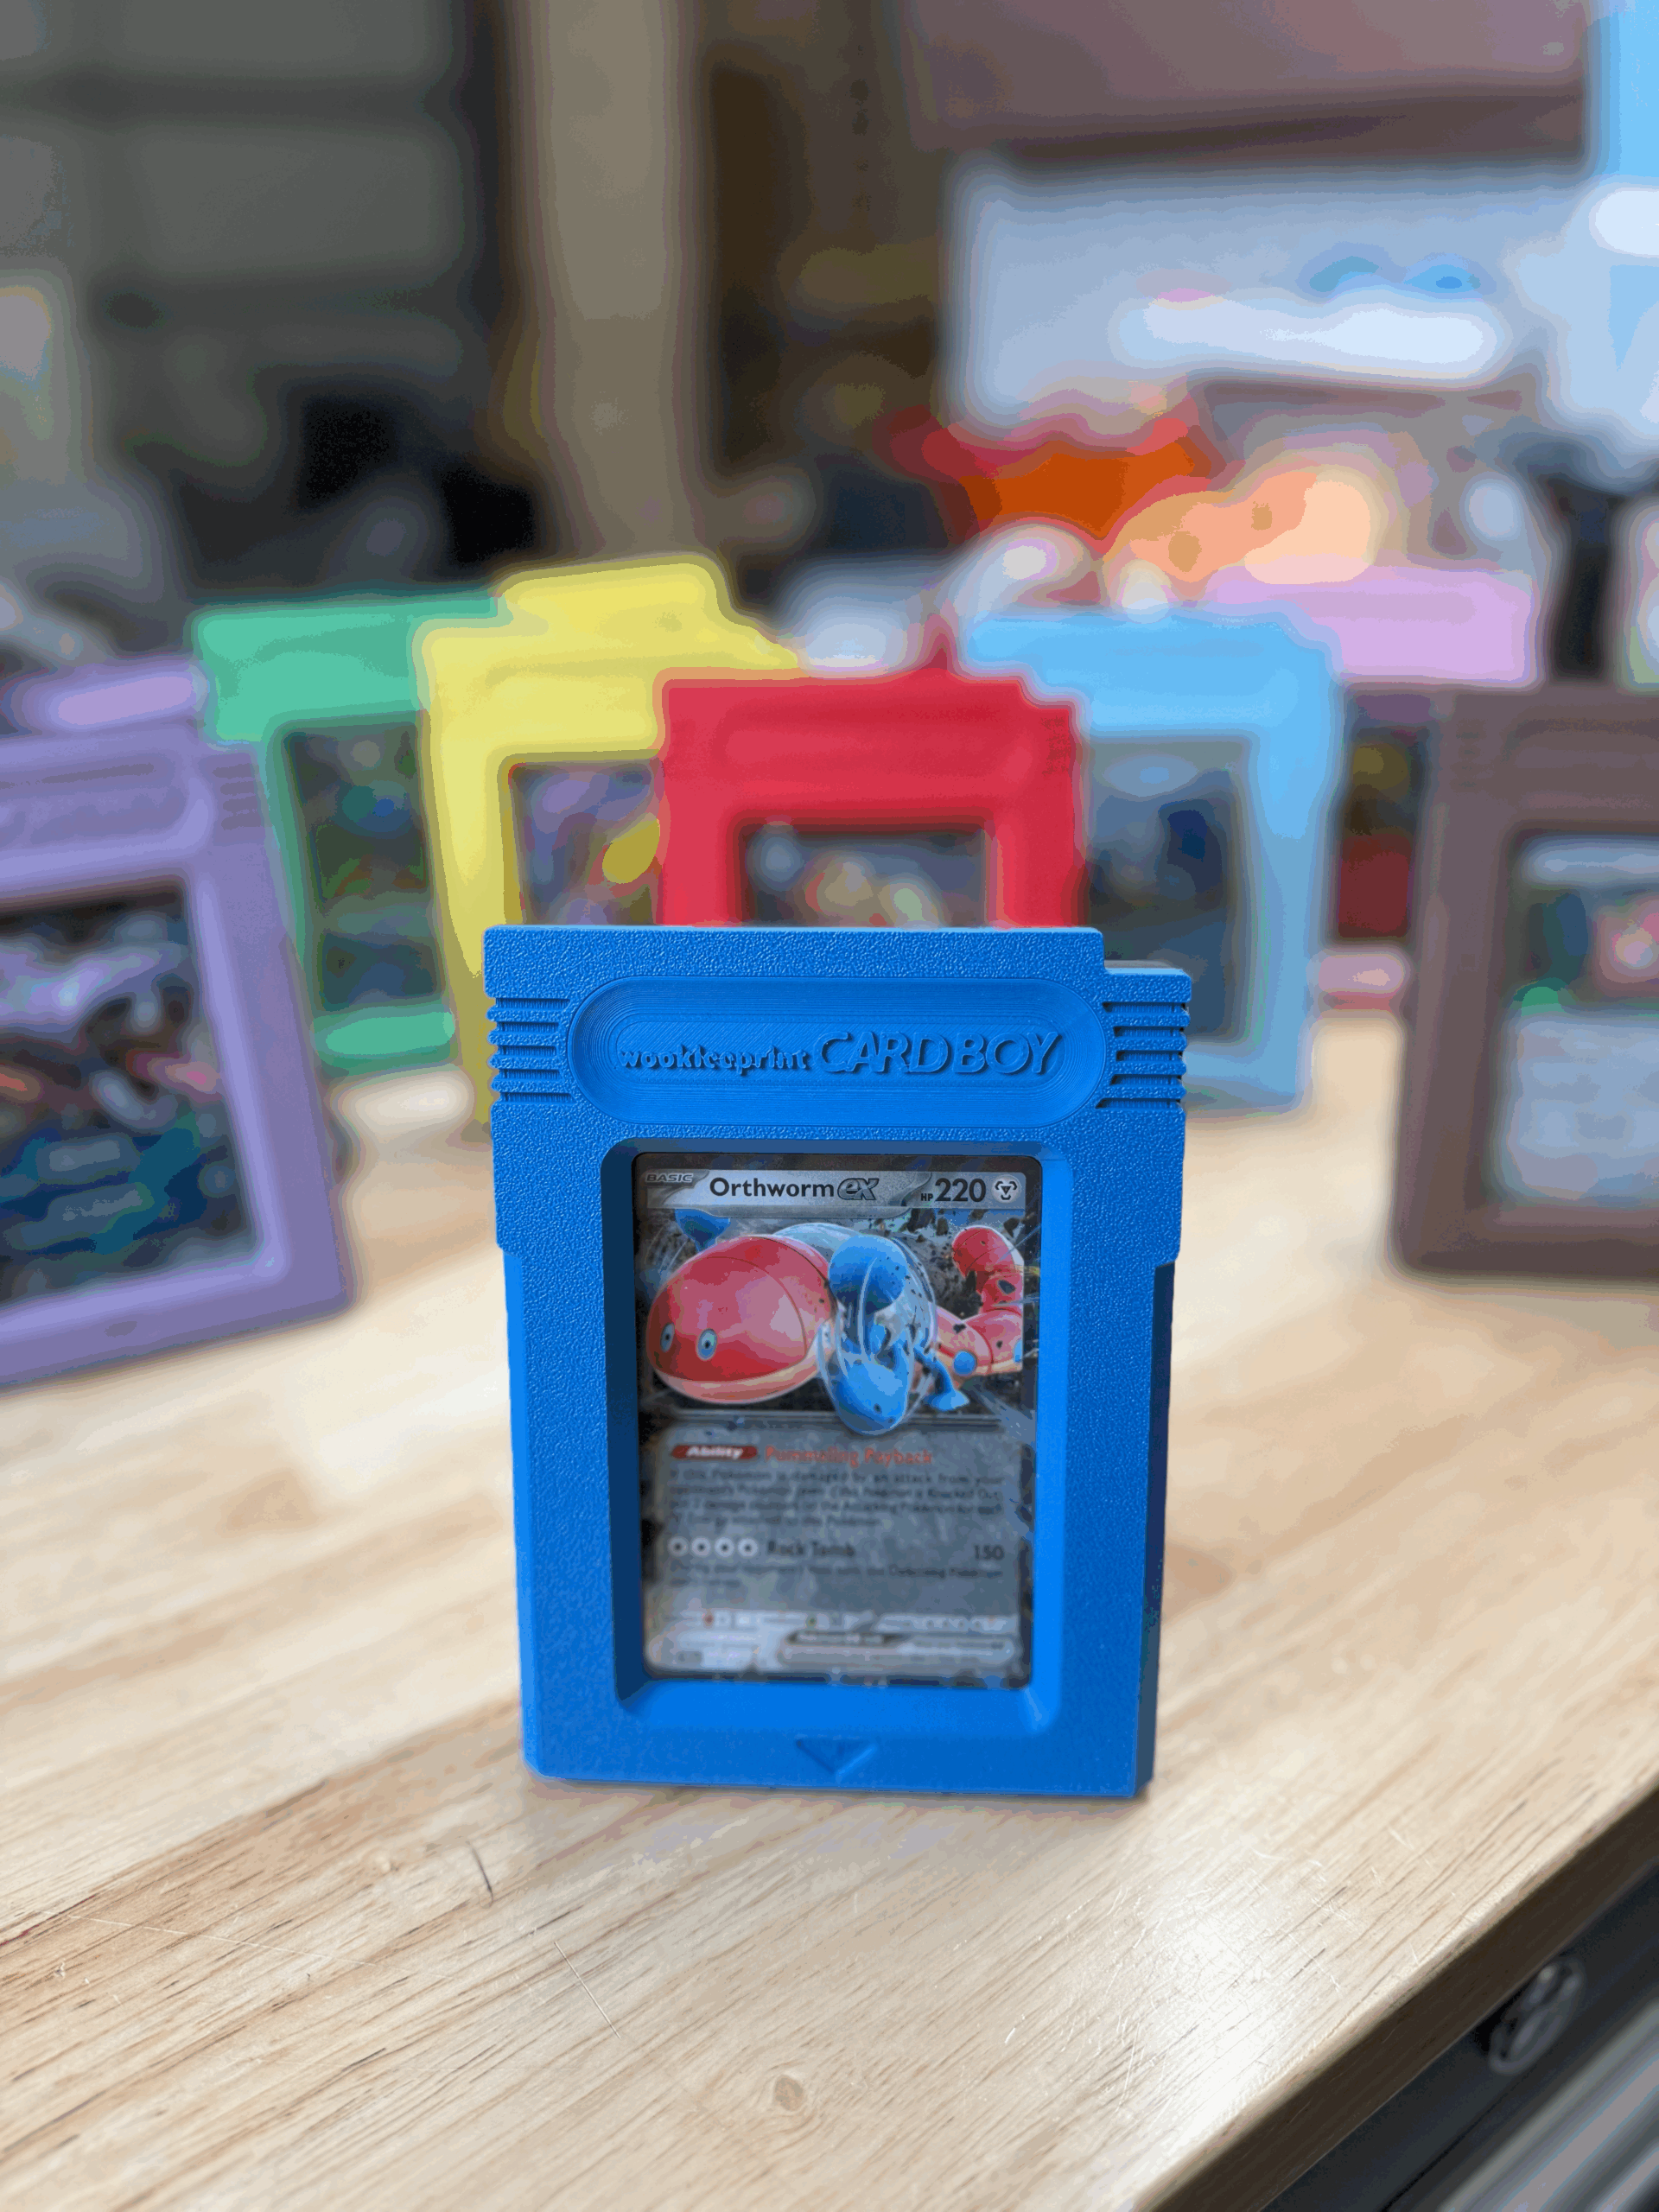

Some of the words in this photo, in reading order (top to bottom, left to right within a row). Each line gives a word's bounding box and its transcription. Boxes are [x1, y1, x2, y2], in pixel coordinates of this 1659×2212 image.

[645, 1173, 694, 1184] BASIC
[709, 1176, 835, 1198] Orthworm
[920, 1192, 934, 1202] HP
[934, 1177, 987, 1203] 220
[974, 1544, 1005, 1561] 150
